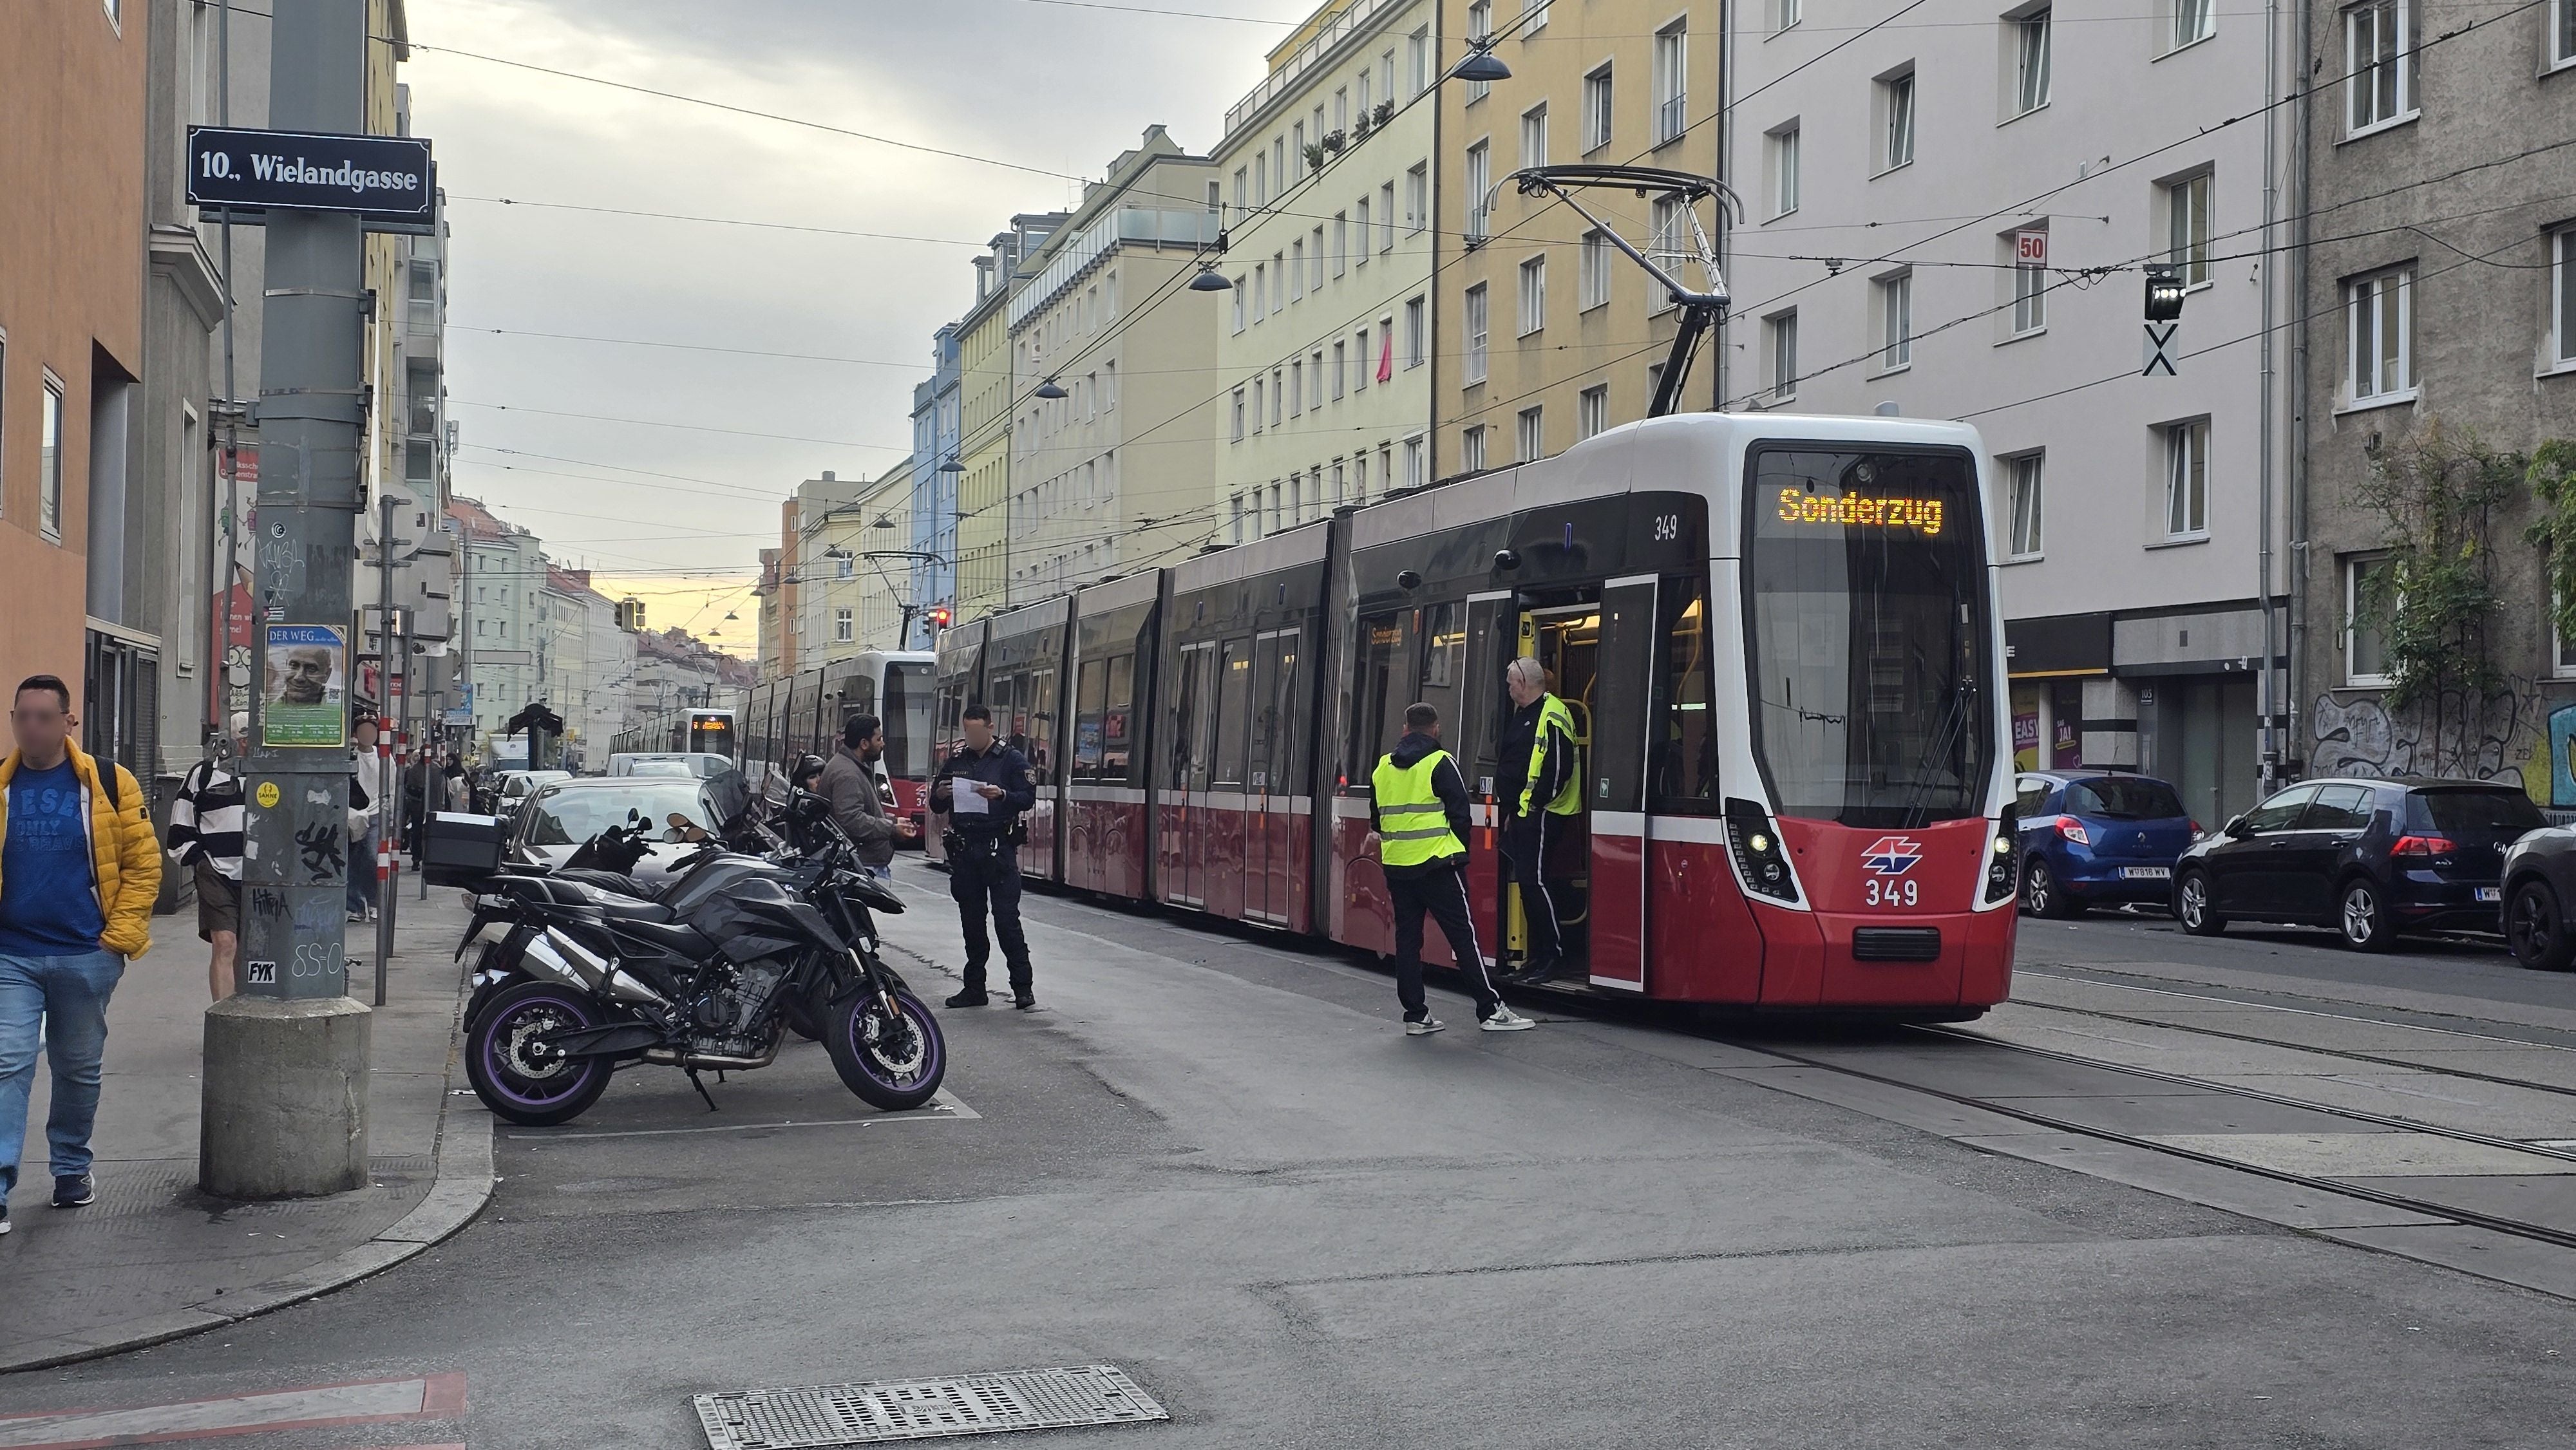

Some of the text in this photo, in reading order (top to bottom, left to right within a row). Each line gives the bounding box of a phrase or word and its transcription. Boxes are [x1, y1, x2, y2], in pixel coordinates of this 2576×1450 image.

[201, 151, 418, 193] 10., Wielandgasse
[2020, 237, 2043, 259] 50
[1778, 486, 1942, 534] Sonderzug
[1654, 514, 1678, 541] 349
[270, 631, 289, 641] DER
[290, 630, 314, 641] WEG
[2141, 688, 2152, 699] 105
[15, 820, 61, 836] ONLY
[1866, 880, 1918, 906] 349
[249, 963, 274, 982] FYK
